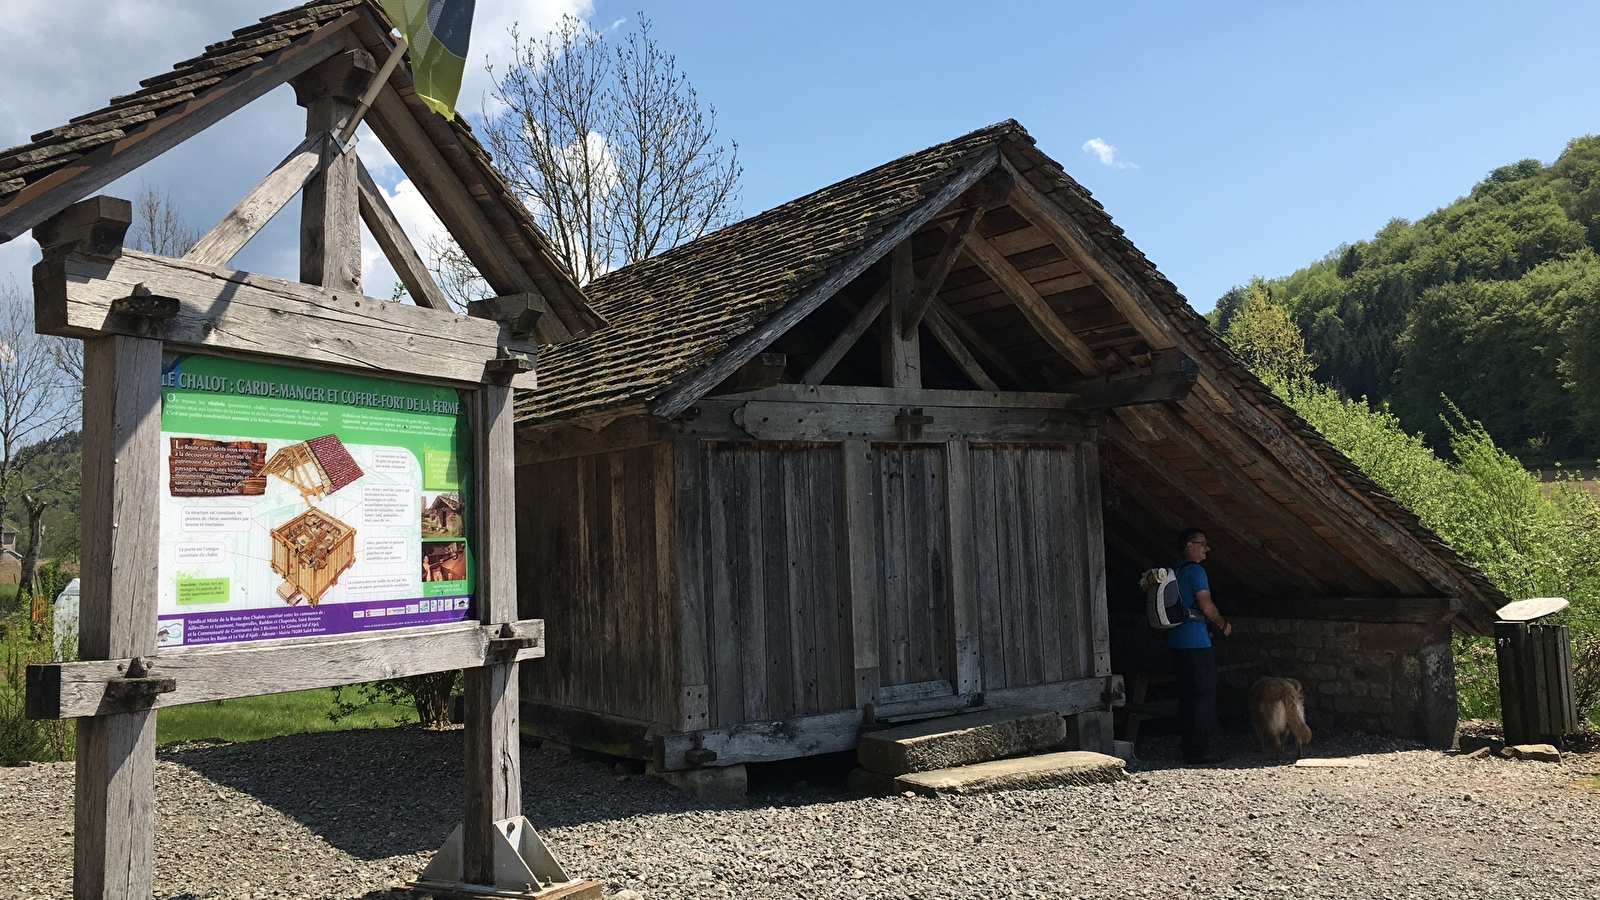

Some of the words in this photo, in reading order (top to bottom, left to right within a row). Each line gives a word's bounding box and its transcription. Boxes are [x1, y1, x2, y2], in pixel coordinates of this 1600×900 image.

[162, 372, 175, 387] LE
[178, 373, 227, 392] CHALOT
[236, 378, 325, 402] GARDE-MANGER
[328, 388, 339, 404] ET
[341, 390, 405, 410] COFFRE-FORT
[407, 397, 419, 412] DE
[421, 398, 431, 413] LA
